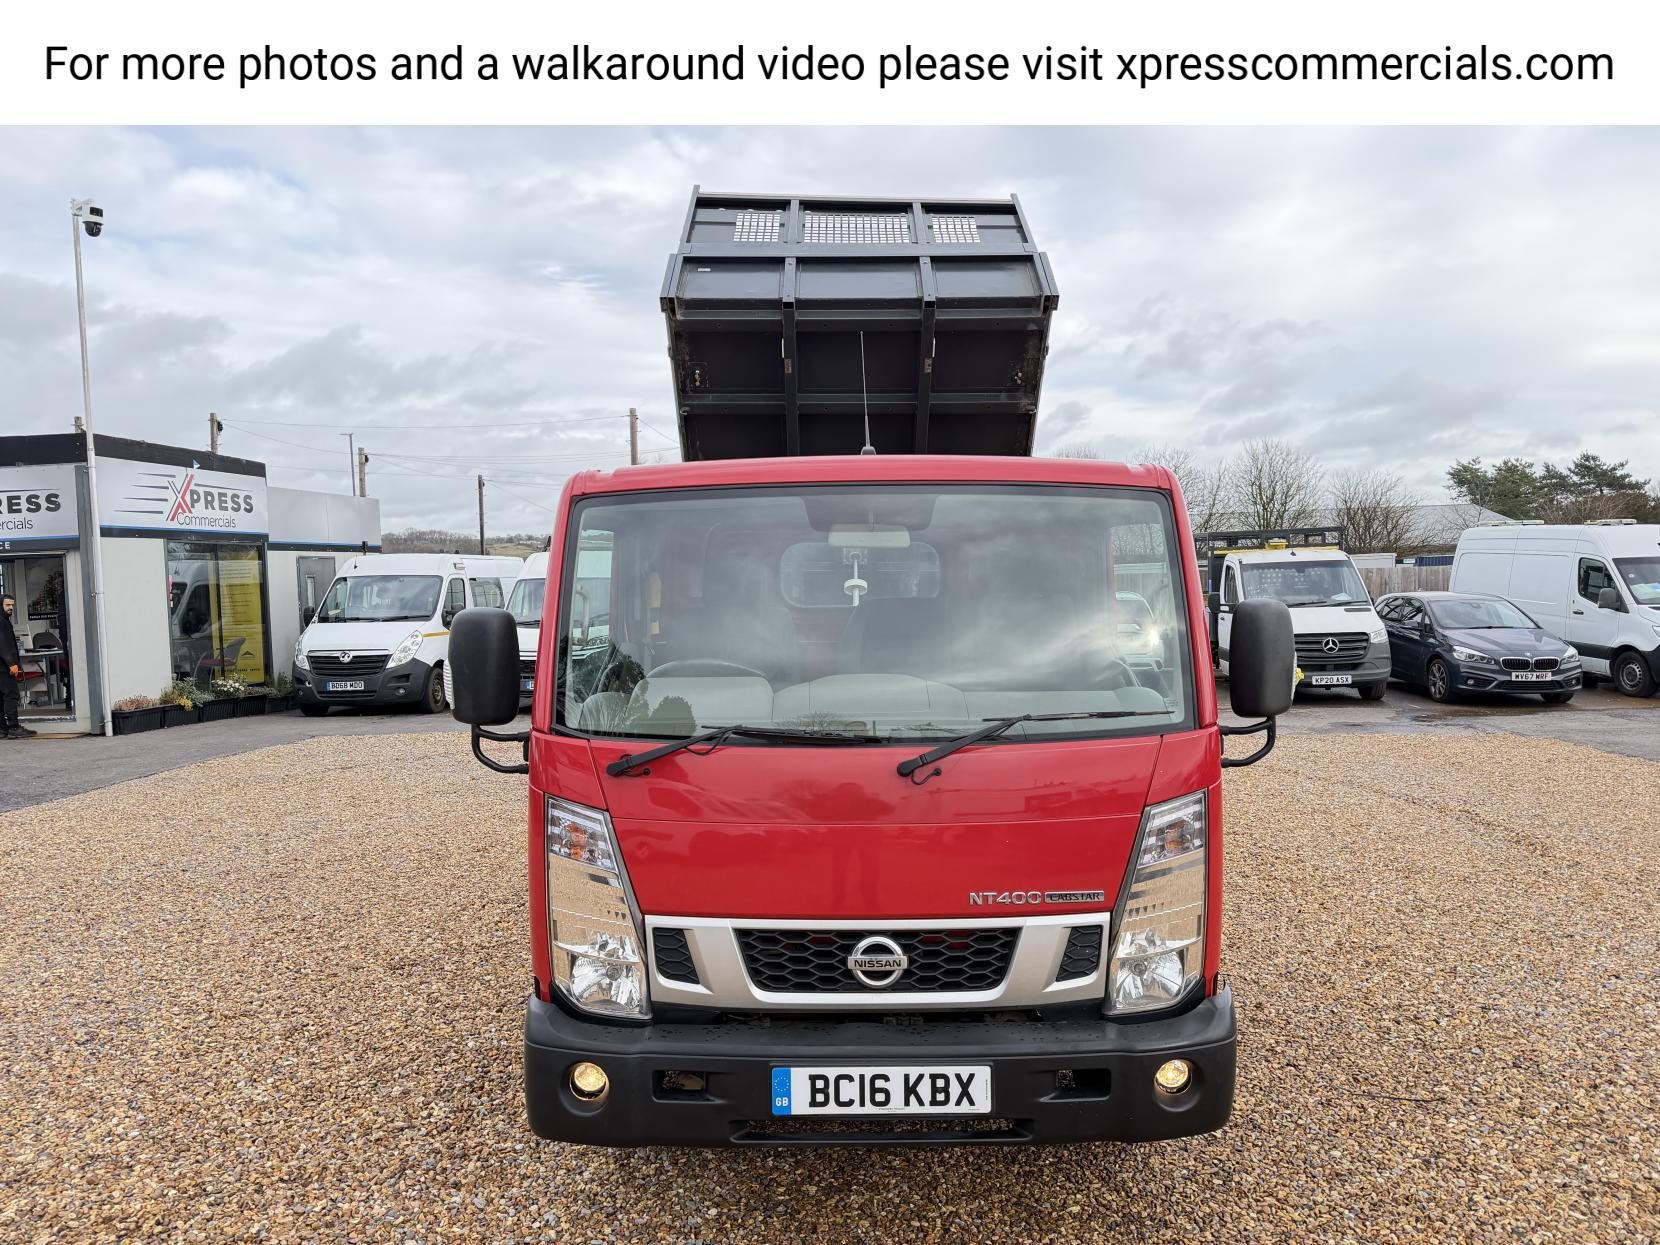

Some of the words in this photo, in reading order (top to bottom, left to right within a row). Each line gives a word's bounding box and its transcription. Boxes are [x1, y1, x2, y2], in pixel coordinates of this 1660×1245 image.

[0, 493, 61, 514] ESS
[166, 473, 254, 521] XPRESS
[177, 512, 236, 528] Commercials
[1315, 676, 1334, 684] KP20
[1335, 676, 1350, 684] ASX
[969, 892, 1041, 905] NT400
[1049, 892, 1100, 902] CABSTAR
[854, 959, 901, 968] NISSAN
[775, 1097, 789, 1107] GB
[808, 1073, 891, 1108] BC16
[903, 1073, 976, 1107] KBX
